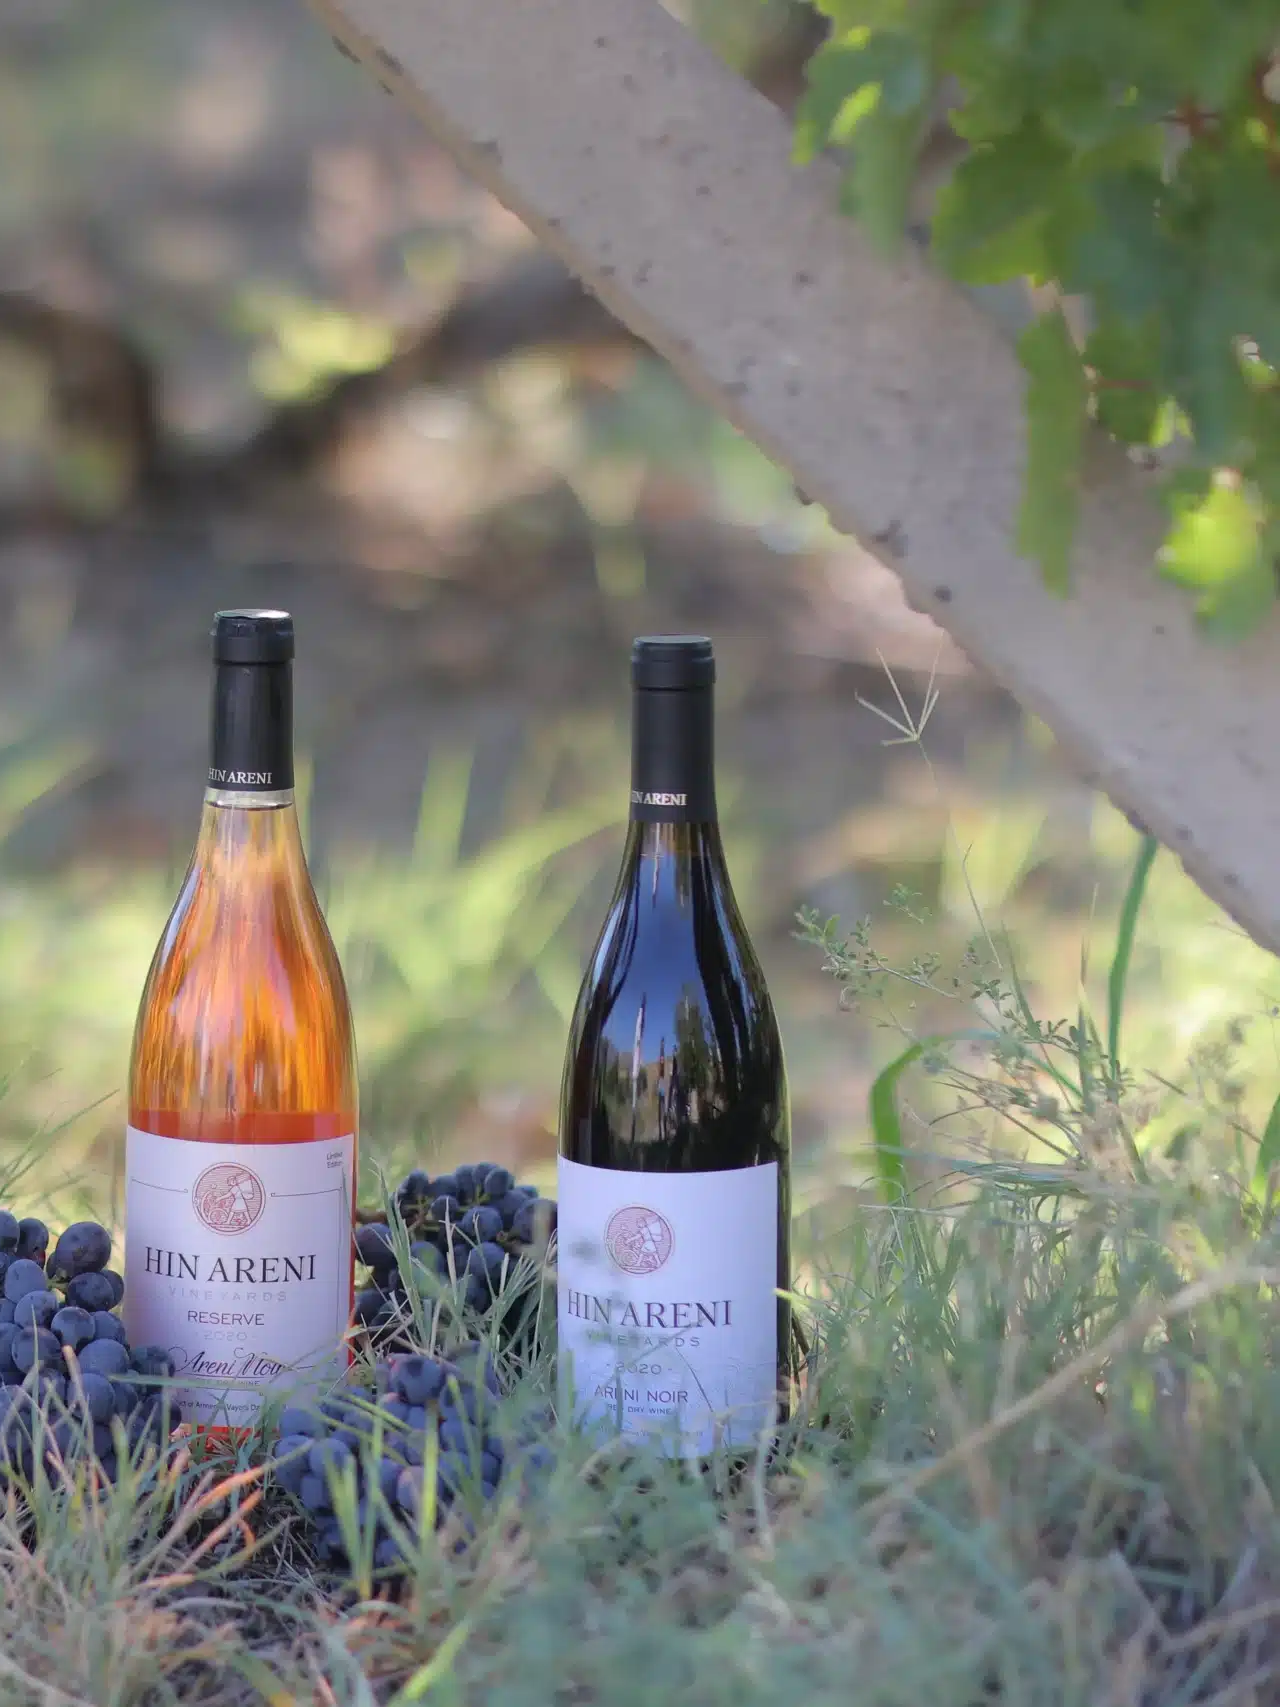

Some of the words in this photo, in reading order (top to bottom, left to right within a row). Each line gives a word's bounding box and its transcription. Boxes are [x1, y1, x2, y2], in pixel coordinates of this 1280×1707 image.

[208, 767, 226, 782] HIN
[227, 771, 273, 784] ARENI
[644, 792, 688, 806] ARENI
[145, 1246, 200, 1281] HIN
[207, 1254, 317, 1284] ARENI
[169, 1286, 287, 1302] VINEYARDS
[567, 1289, 613, 1324] HIN
[620, 1299, 732, 1328] ARENI
[187, 1310, 265, 1326] RESERVE
[204, 1330, 248, 1342] 2020
[168, 1346, 236, 1376] Areni
[647, 1391, 689, 1404] NOIR
[608, 1403, 624, 1411] RE
[649, 1407, 672, 1415] WINE
